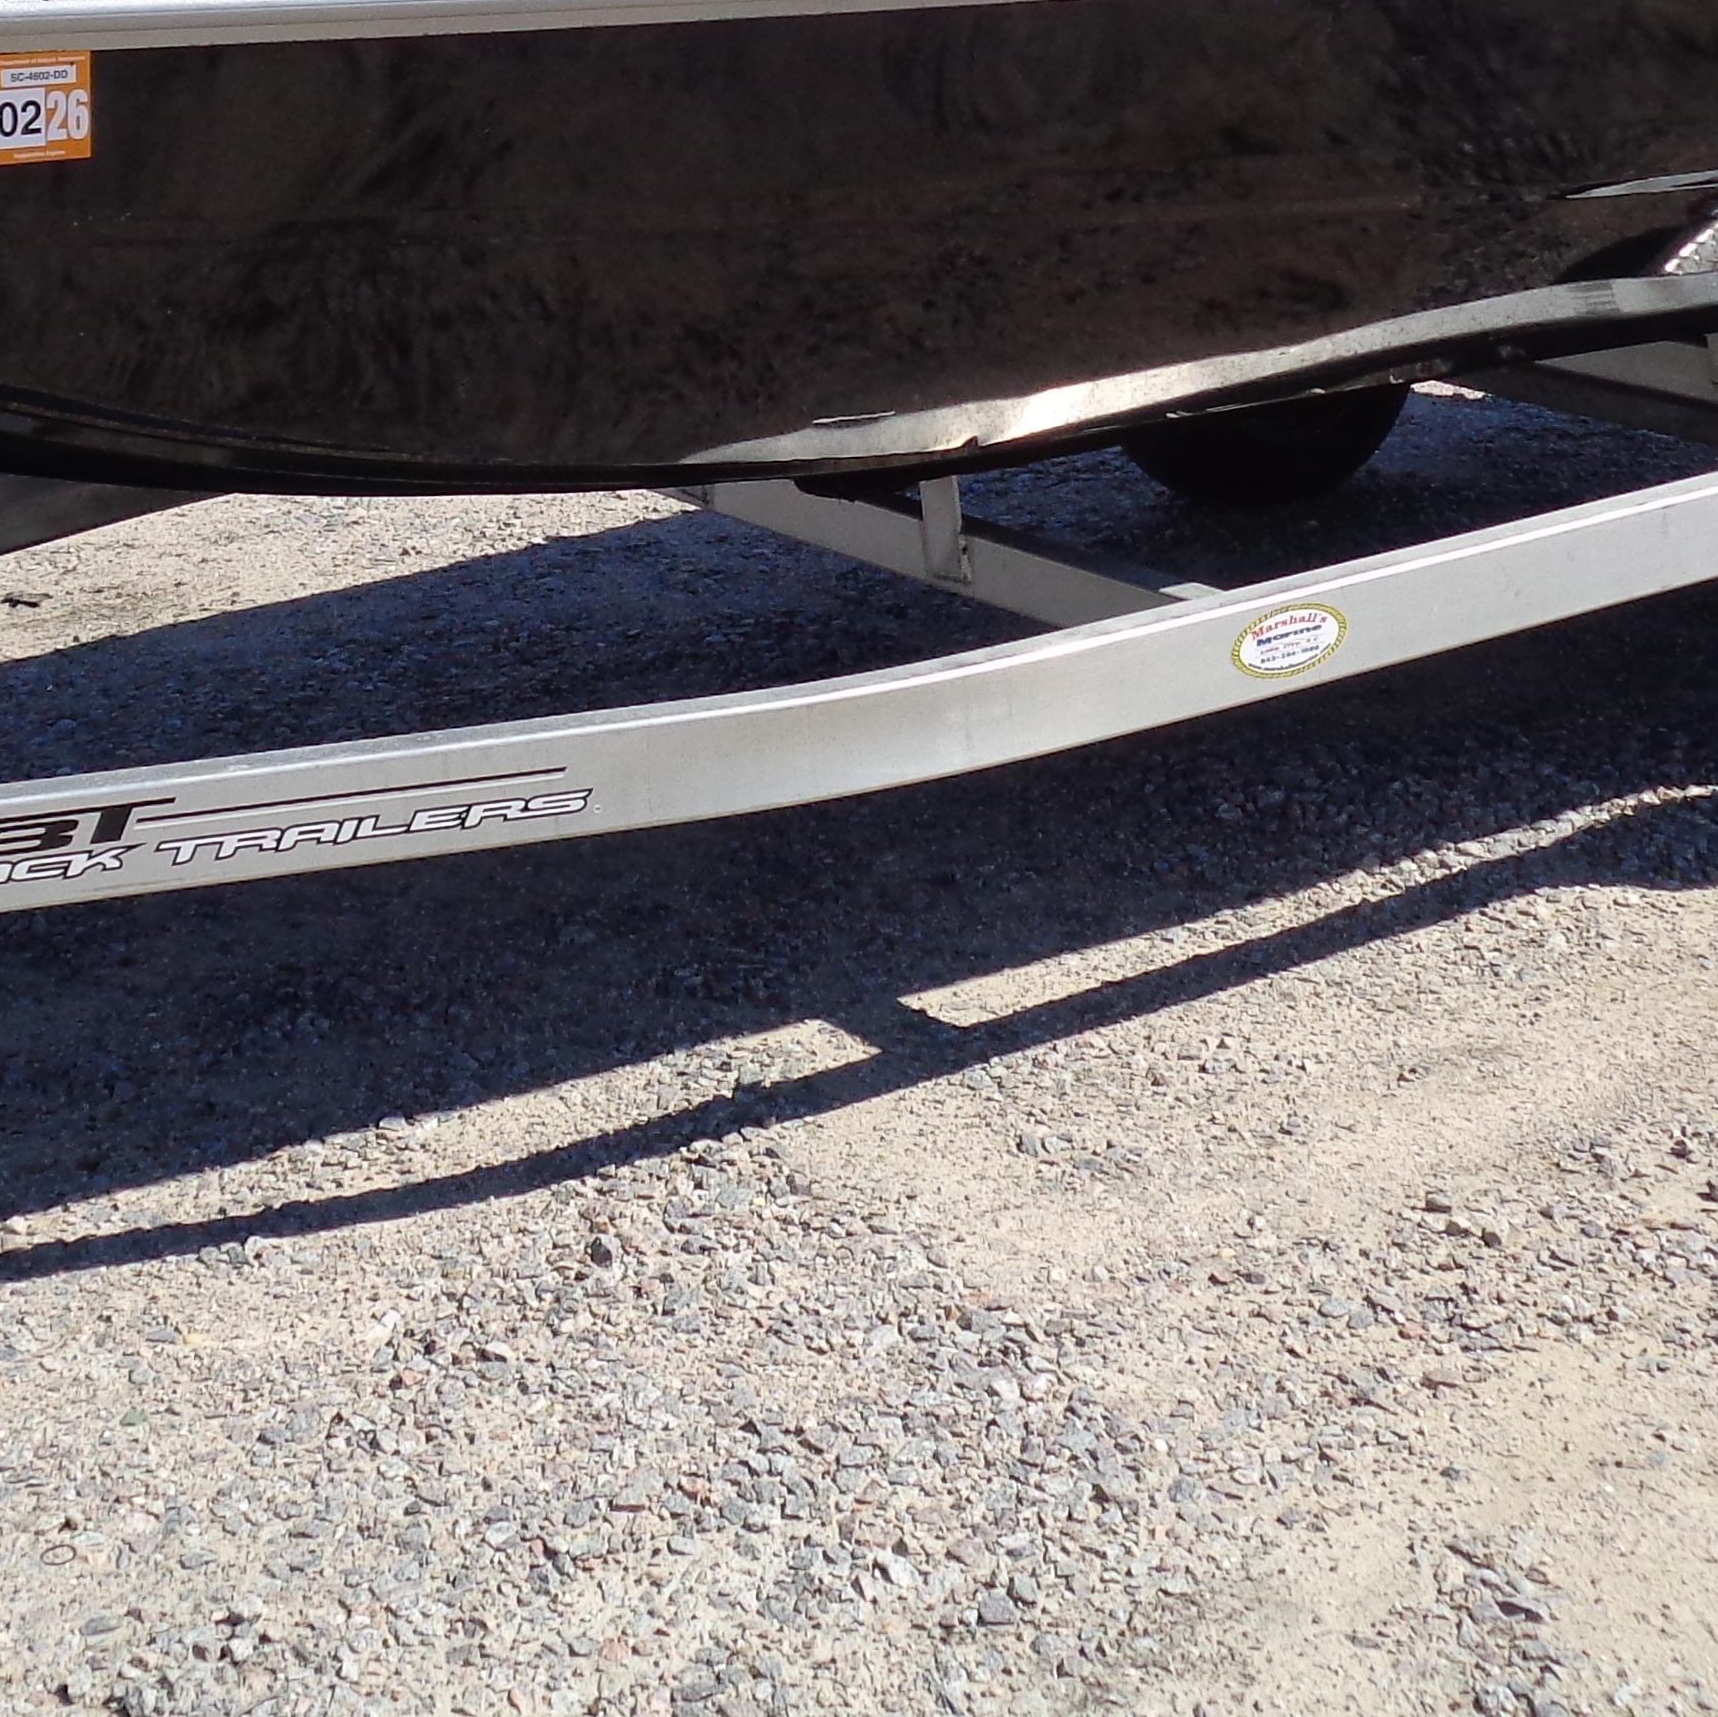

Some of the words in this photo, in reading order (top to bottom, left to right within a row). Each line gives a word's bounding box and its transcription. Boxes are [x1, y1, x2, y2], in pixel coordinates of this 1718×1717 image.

[46, 88, 90, 141] 26
[1251, 612, 1327, 641] Marshall's
[156, 789, 593, 864] TRAILERS
